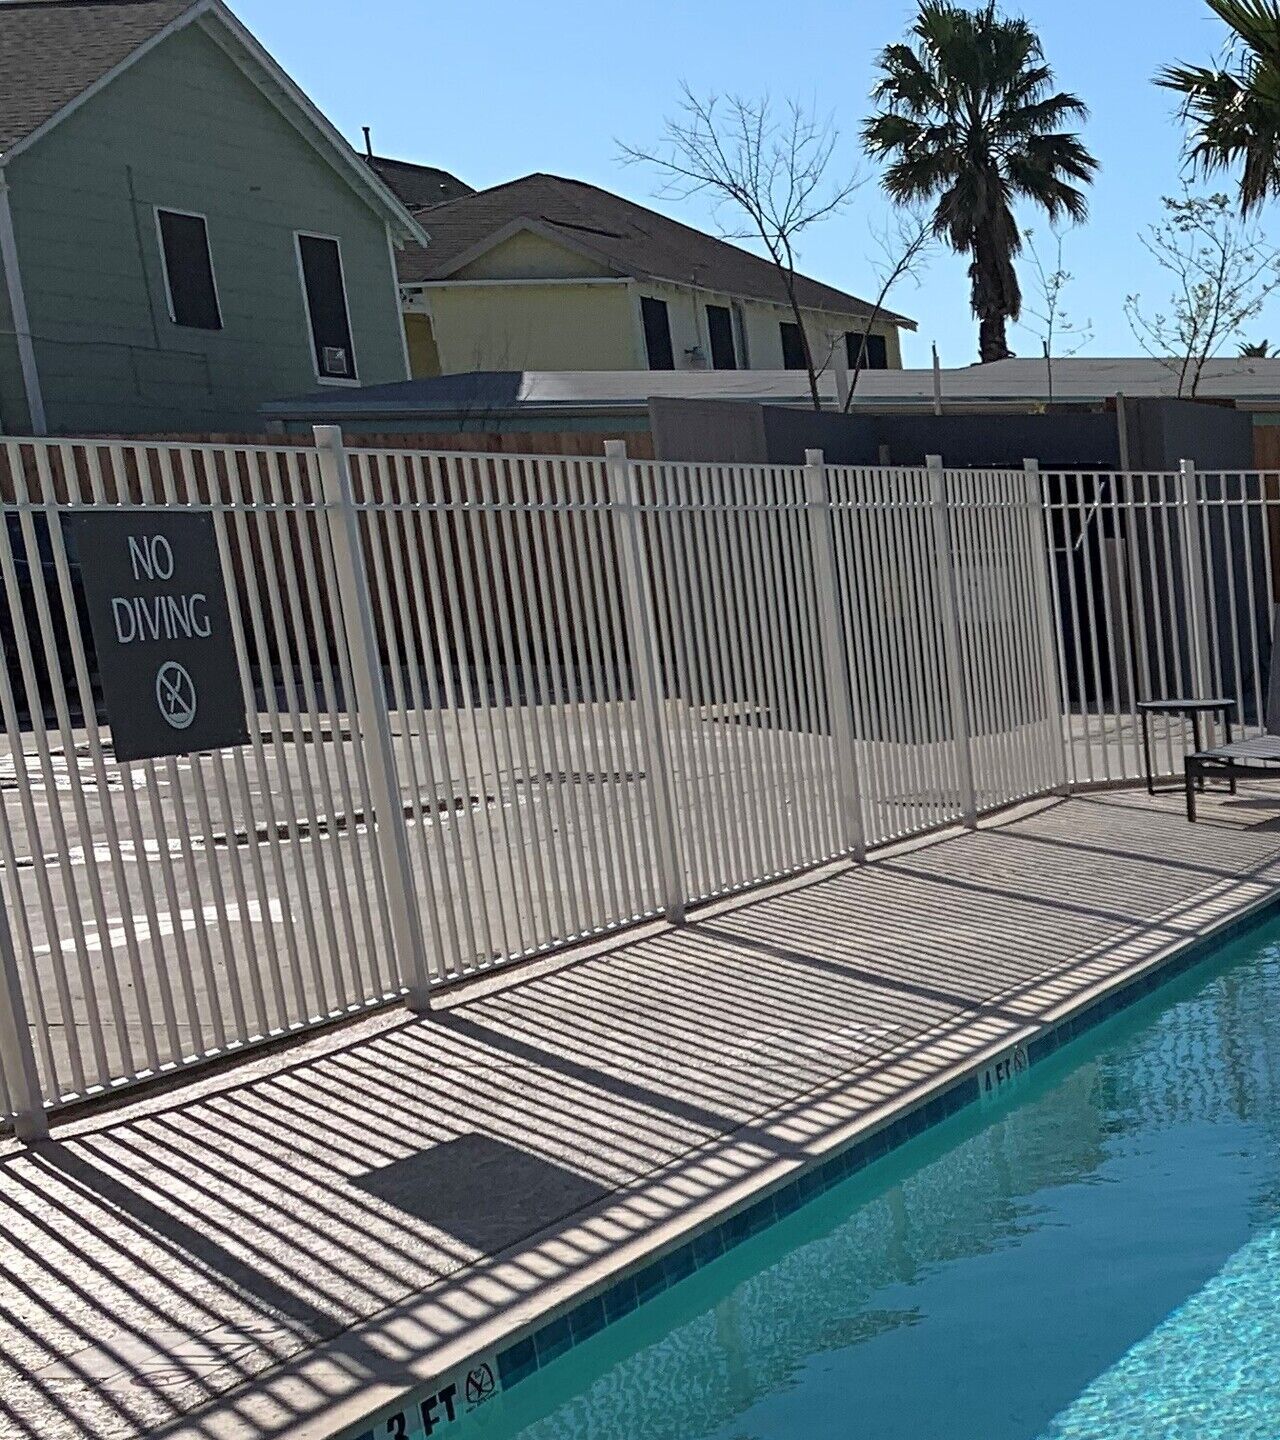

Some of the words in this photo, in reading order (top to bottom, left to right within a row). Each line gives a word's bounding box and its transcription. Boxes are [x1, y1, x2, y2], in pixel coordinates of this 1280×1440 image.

[128, 535, 174, 580] NO
[112, 593, 212, 643] DIVING
[995, 1058, 1011, 1086] FT
[420, 1383, 457, 1437] FT
